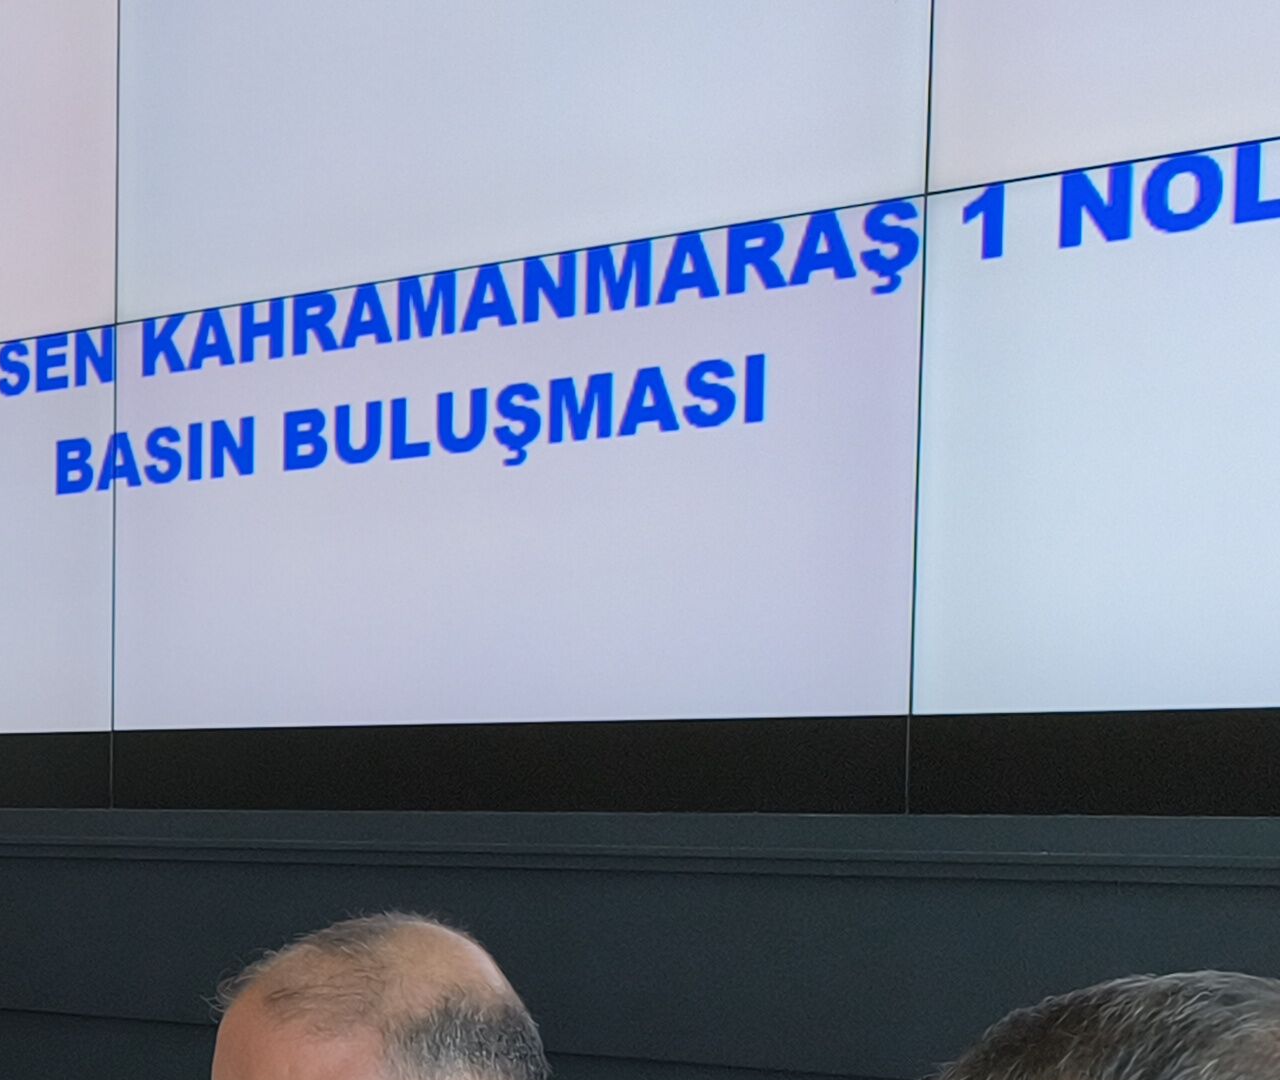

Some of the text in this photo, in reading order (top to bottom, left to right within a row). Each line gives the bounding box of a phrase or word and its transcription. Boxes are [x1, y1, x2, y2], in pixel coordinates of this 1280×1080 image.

[141, 197, 921, 376] KAHRAMANMARAŞ
[962, 182, 1005, 260] 1
[55, 353, 766, 495] BASIN BULUŞMASI
